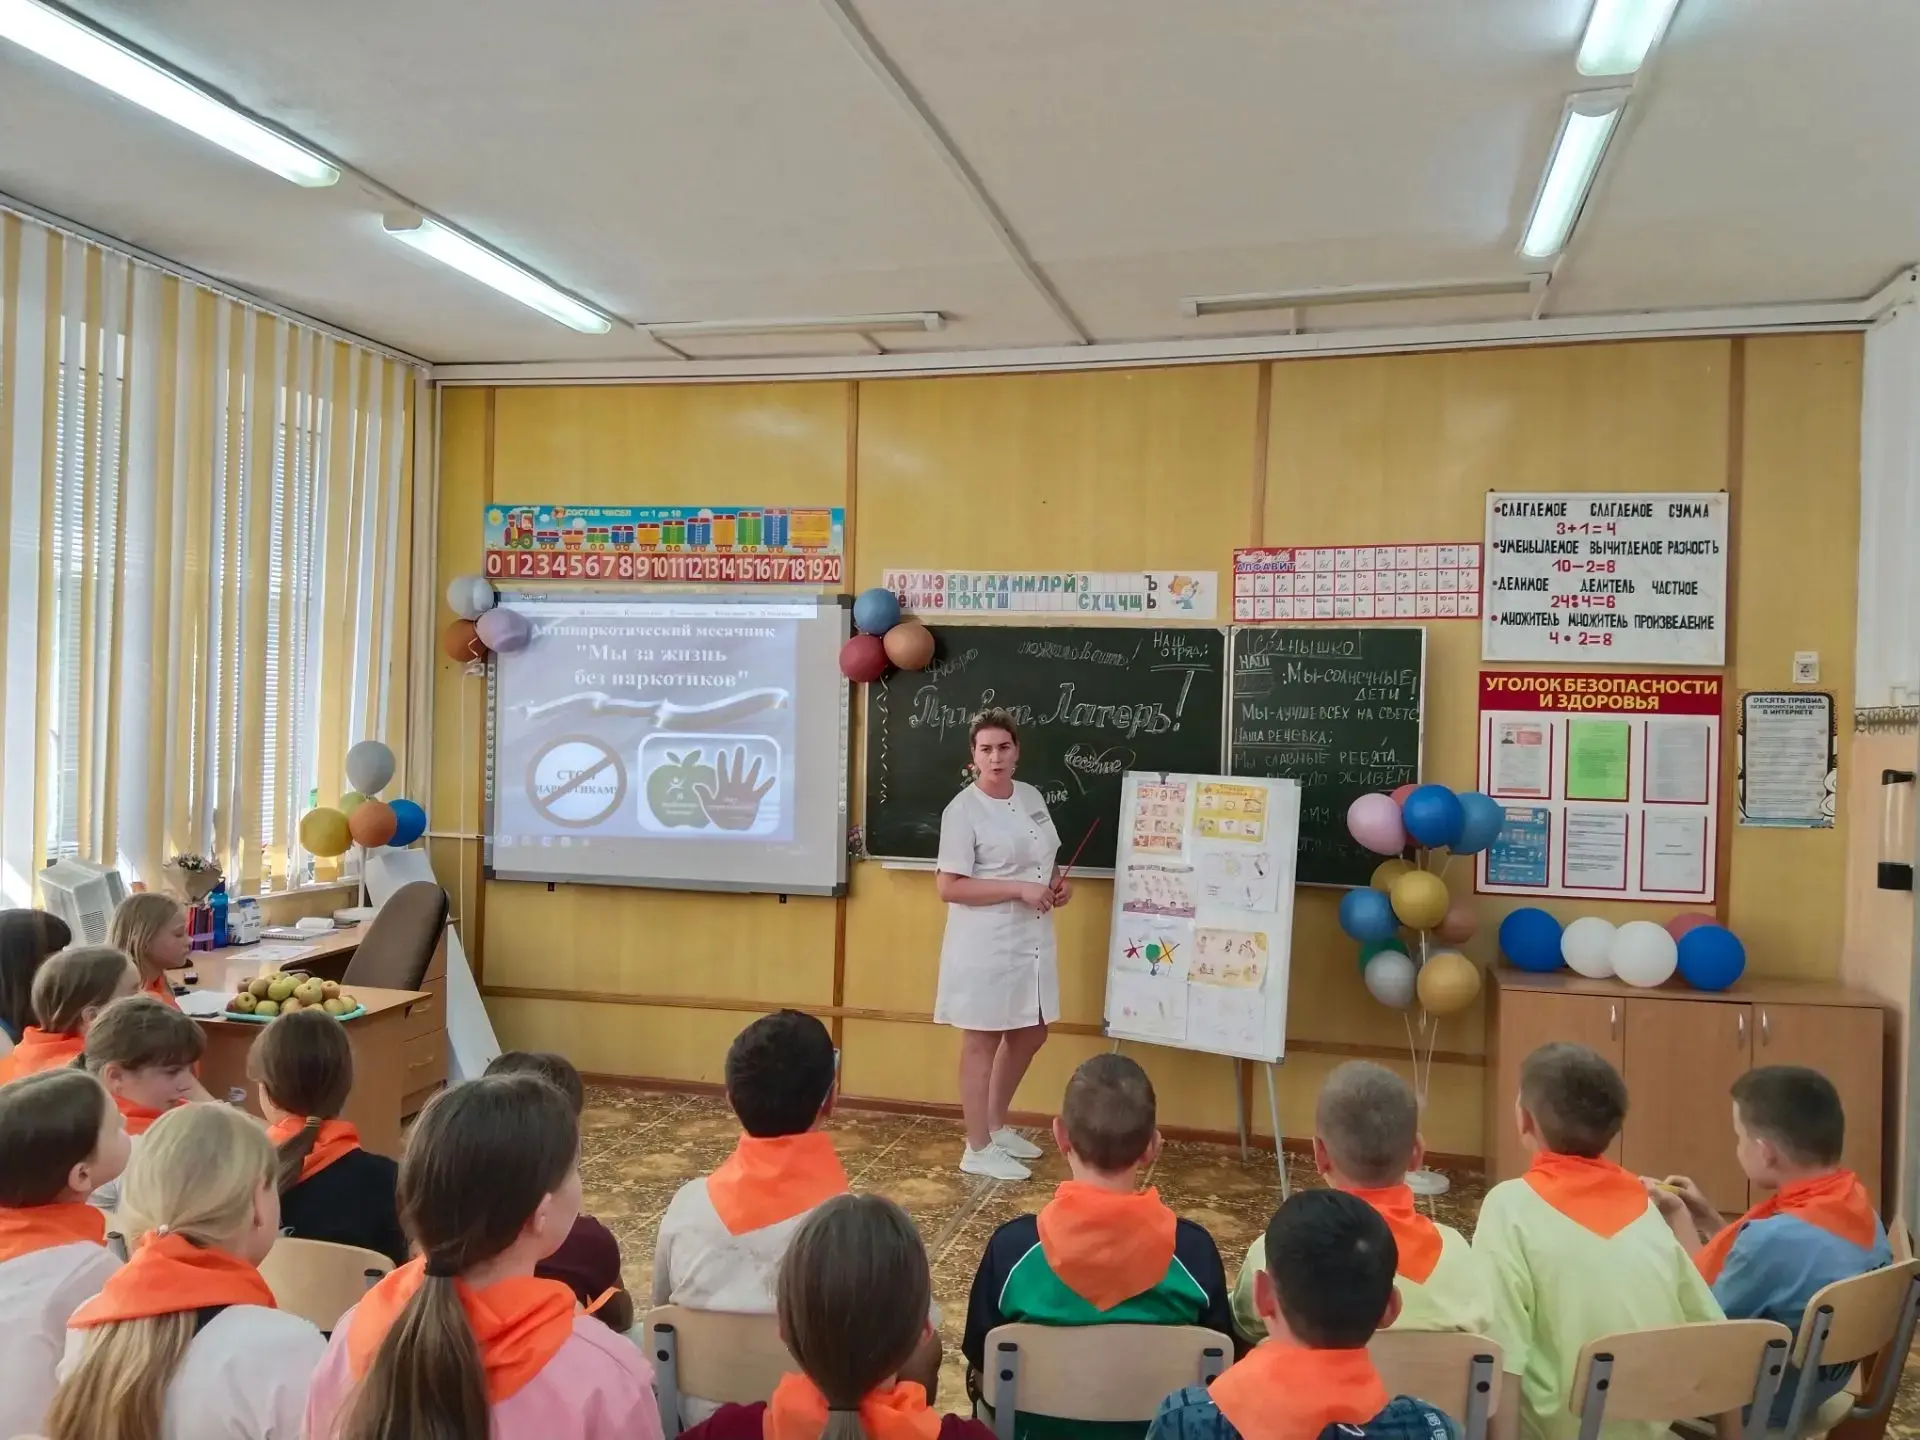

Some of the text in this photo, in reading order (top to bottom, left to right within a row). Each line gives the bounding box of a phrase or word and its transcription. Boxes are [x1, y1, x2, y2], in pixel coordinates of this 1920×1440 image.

[1502, 503, 1709, 518] СЛАГАЕМОЕ СЛАГАЕМОЕ СУММА
[1500, 540, 1719, 556] УМЕНЬШАЕМОЕ ВЫЧИТАЕМОЕ РАЗНОСТЬ
[488, 554, 841, 580] 0 1 2 3 4 5 6 7 8 9 10 11 12 13 14 15 16 17 18 19 20
[1498, 577, 1698, 596] ДЕЛИМОЕ ДЕЛИТЕЛЬ ЧАСТНОЕ
[1500, 612, 1715, 631] МНОЖИТЕЛЬ МНОЖИТЕЛЬ ПРОИЗВЕДЕНИЕ
[1154, 631, 1186, 648] НАШ
[661, 649, 727, 662] жизнь
[574, 669, 606, 686] без
[1486, 677, 1718, 695] УГОЛОК БЕЗОПАСНОСТИ
[1355, 687, 1400, 701] ДЕТИ
[1540, 694, 1659, 711] И ЗДОРОВЬЯ
[1358, 707, 1373, 720] НА
